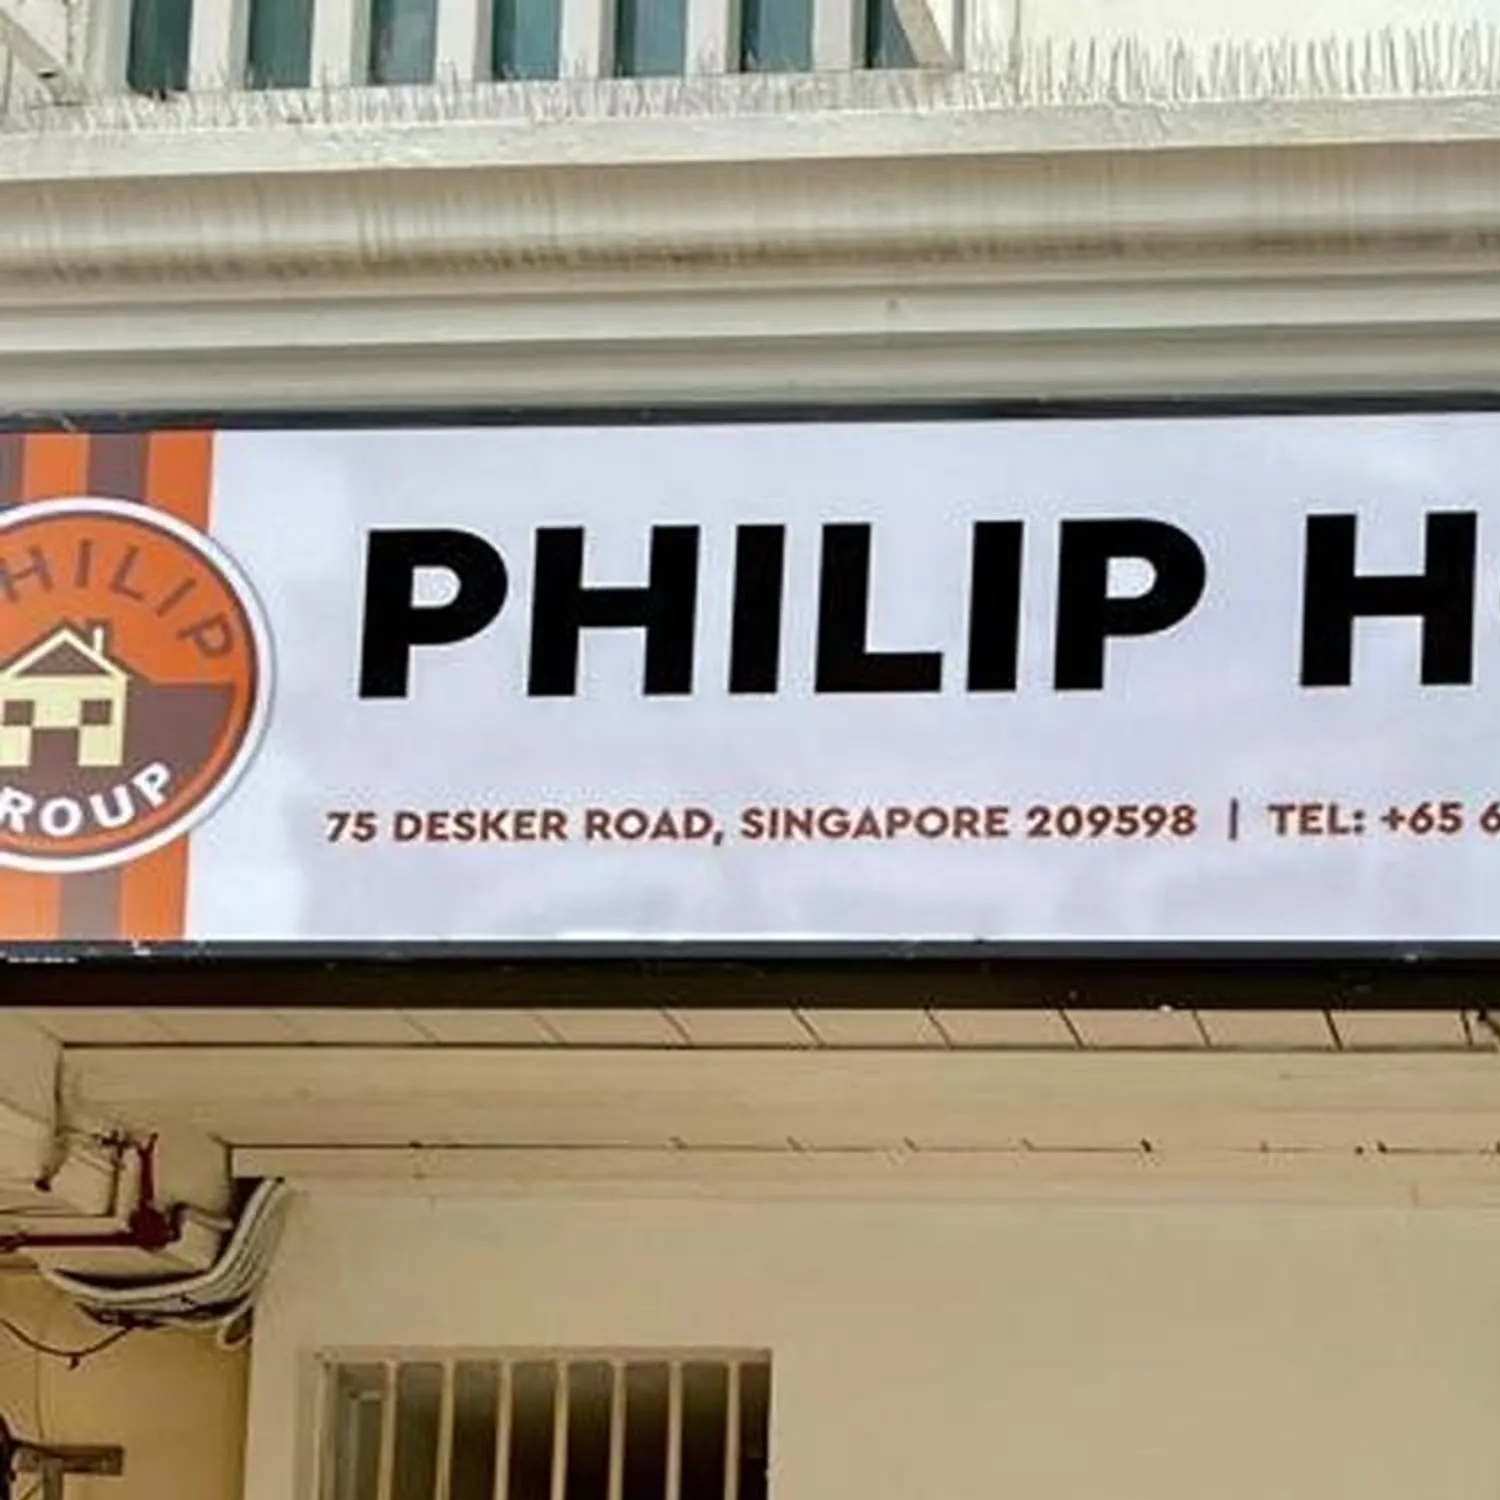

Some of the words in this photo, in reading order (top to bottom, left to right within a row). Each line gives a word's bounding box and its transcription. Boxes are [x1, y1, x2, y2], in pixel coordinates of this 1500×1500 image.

[0, 539, 235, 658] HILIP
[359, 518, 1207, 699] PHILIP
[0, 760, 172, 837] ROUP
[327, 811, 377, 843] 75
[393, 809, 568, 842] DESKER
[584, 808, 724, 847] ROAD,
[740, 805, 1010, 840] SINGAPORE
[1026, 803, 1197, 838] 209598
[1266, 802, 1366, 836] TEL:
[1380, 801, 1463, 835] +65
